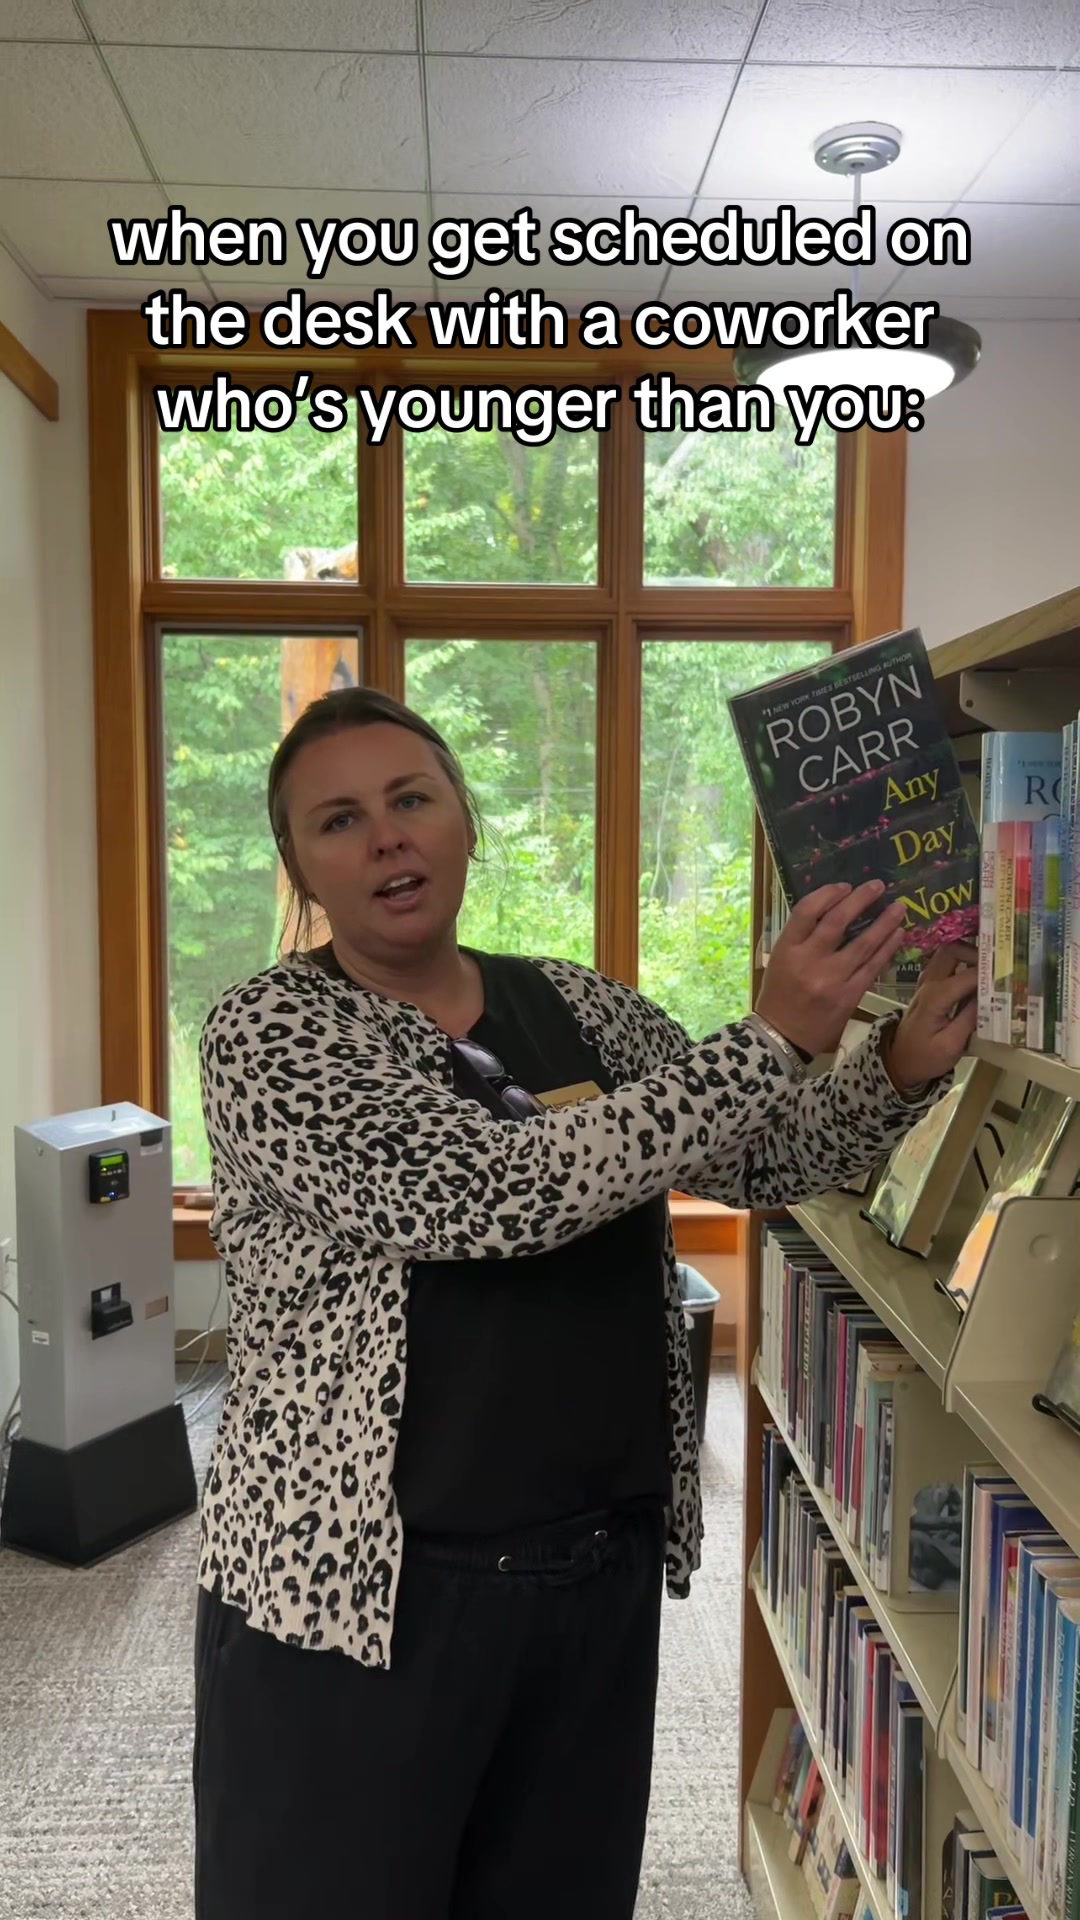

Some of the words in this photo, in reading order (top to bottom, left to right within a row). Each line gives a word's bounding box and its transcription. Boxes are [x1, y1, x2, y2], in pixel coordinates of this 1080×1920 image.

[772, 702, 790, 714] NEW
[790, 694, 810, 707] YORK
[811, 685, 833, 698] TIMES
[833, 665, 882, 689] BESTSELLING
[882, 652, 913, 669] AUTHOR
[766, 664, 922, 758] ROBYN
[799, 718, 920, 792] CARR
[882, 768, 940, 811] Any
[889, 820, 956, 867] Day
[895, 878, 975, 929] Now
[1004, 906, 1012, 942] CARR
